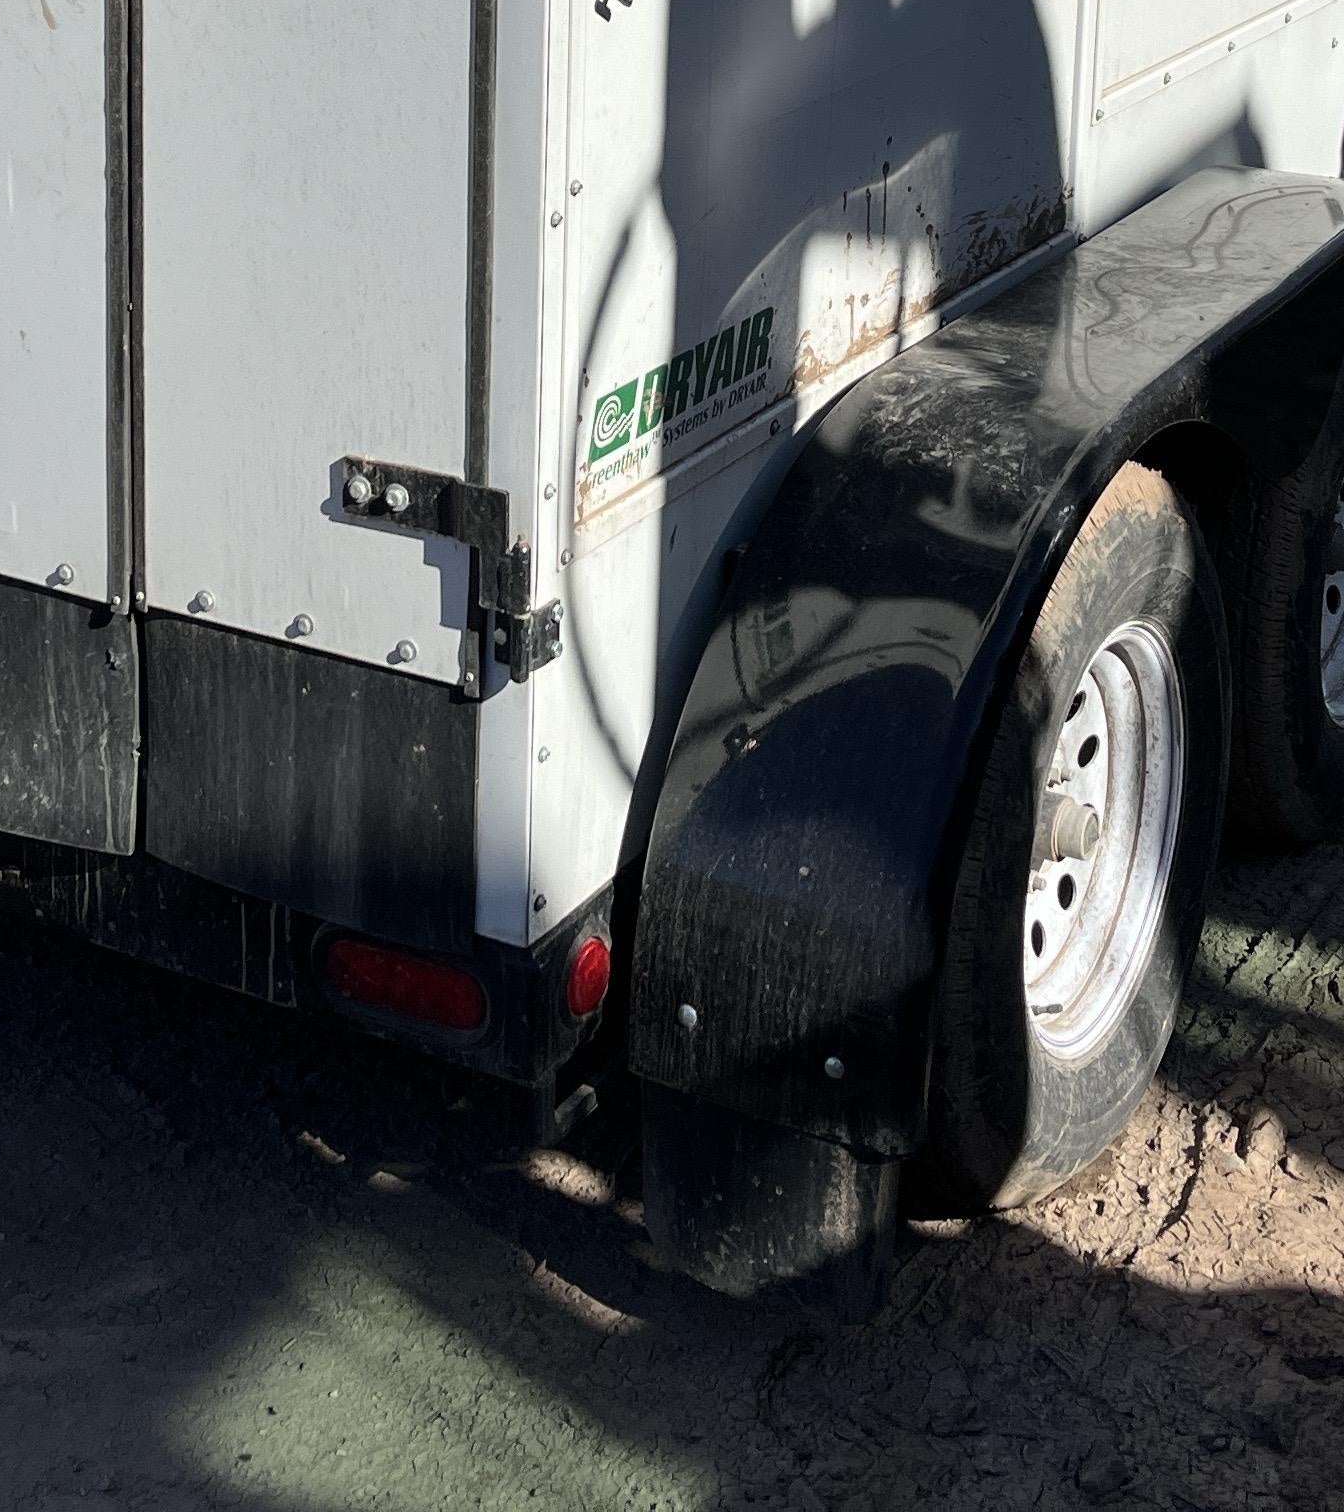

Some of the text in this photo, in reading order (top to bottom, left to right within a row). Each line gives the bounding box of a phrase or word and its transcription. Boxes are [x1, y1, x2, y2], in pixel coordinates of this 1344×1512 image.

[636, 307, 774, 438] DRYAIR
[663, 407, 708, 448] Systems
[711, 397, 725, 419] by
